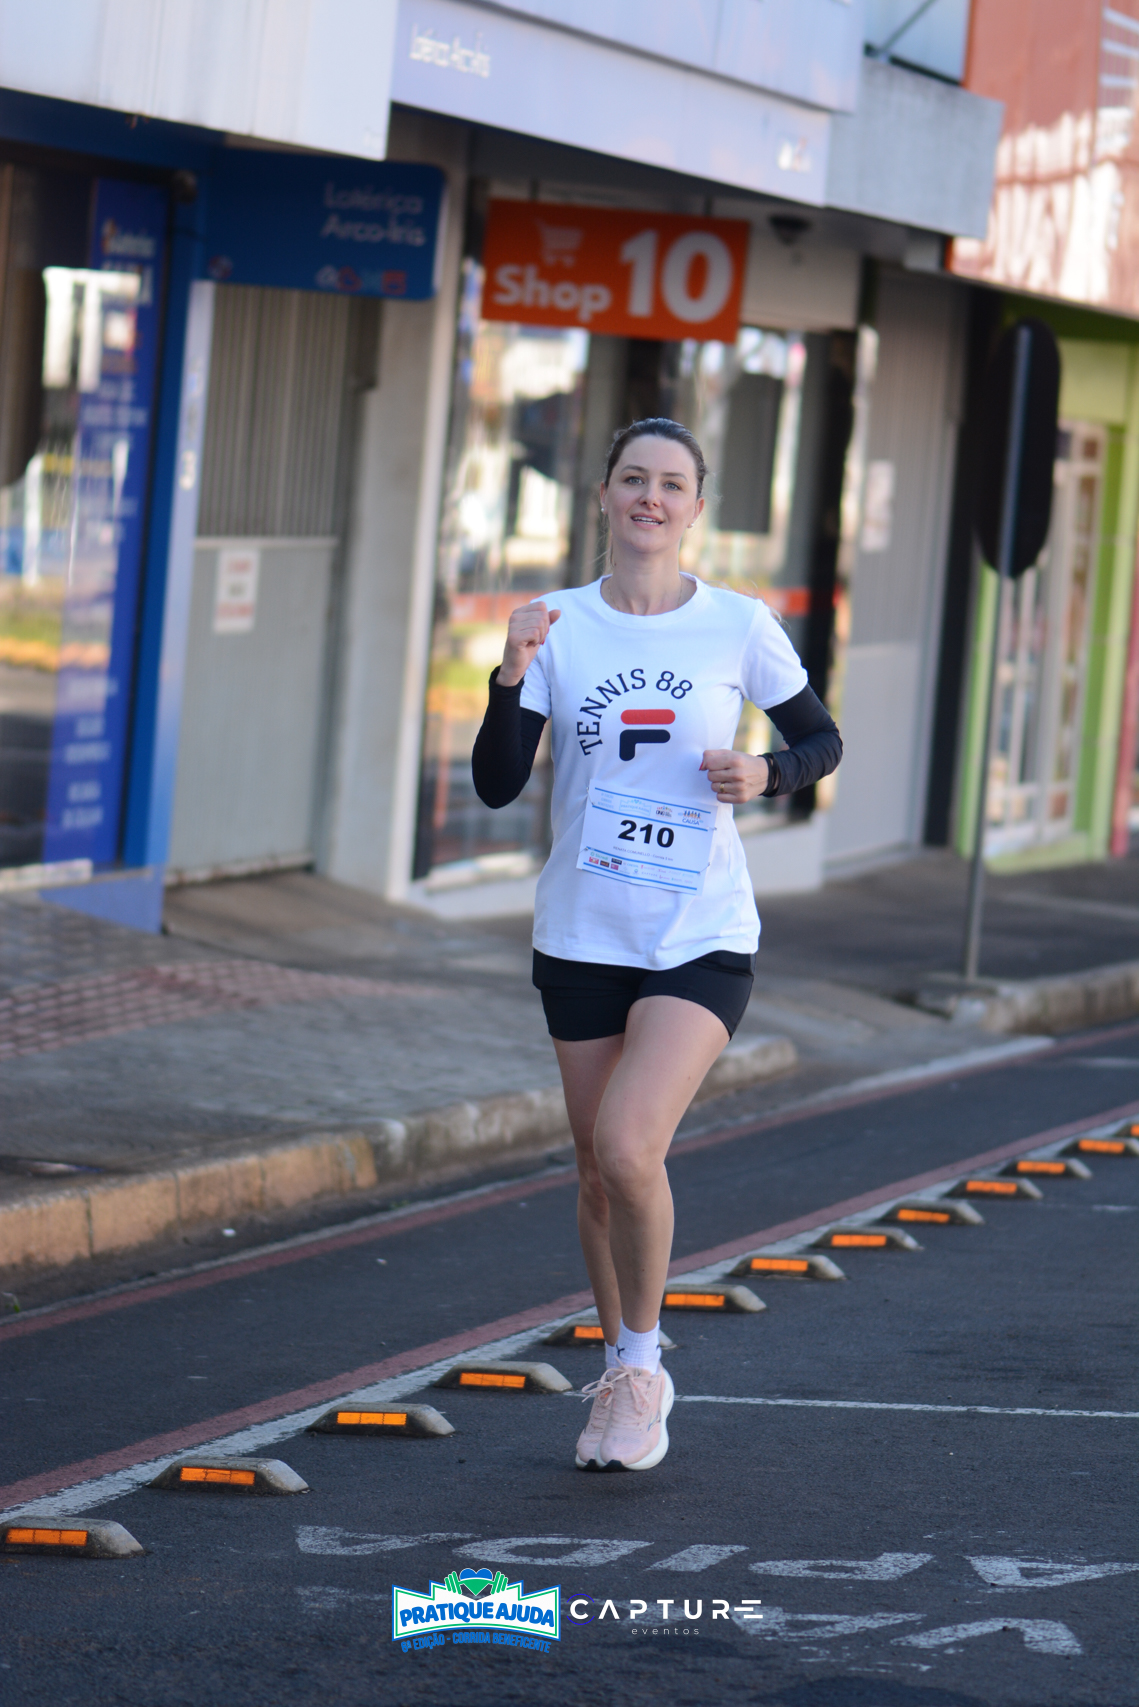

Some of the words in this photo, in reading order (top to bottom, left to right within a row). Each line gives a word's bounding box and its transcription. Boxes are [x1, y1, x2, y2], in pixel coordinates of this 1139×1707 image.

[494, 264, 612, 322] Shop
[620, 229, 735, 324] 10
[576, 668, 647, 756] TENNIS
[655, 670, 693, 700] 88
[617, 819, 675, 848] 210
